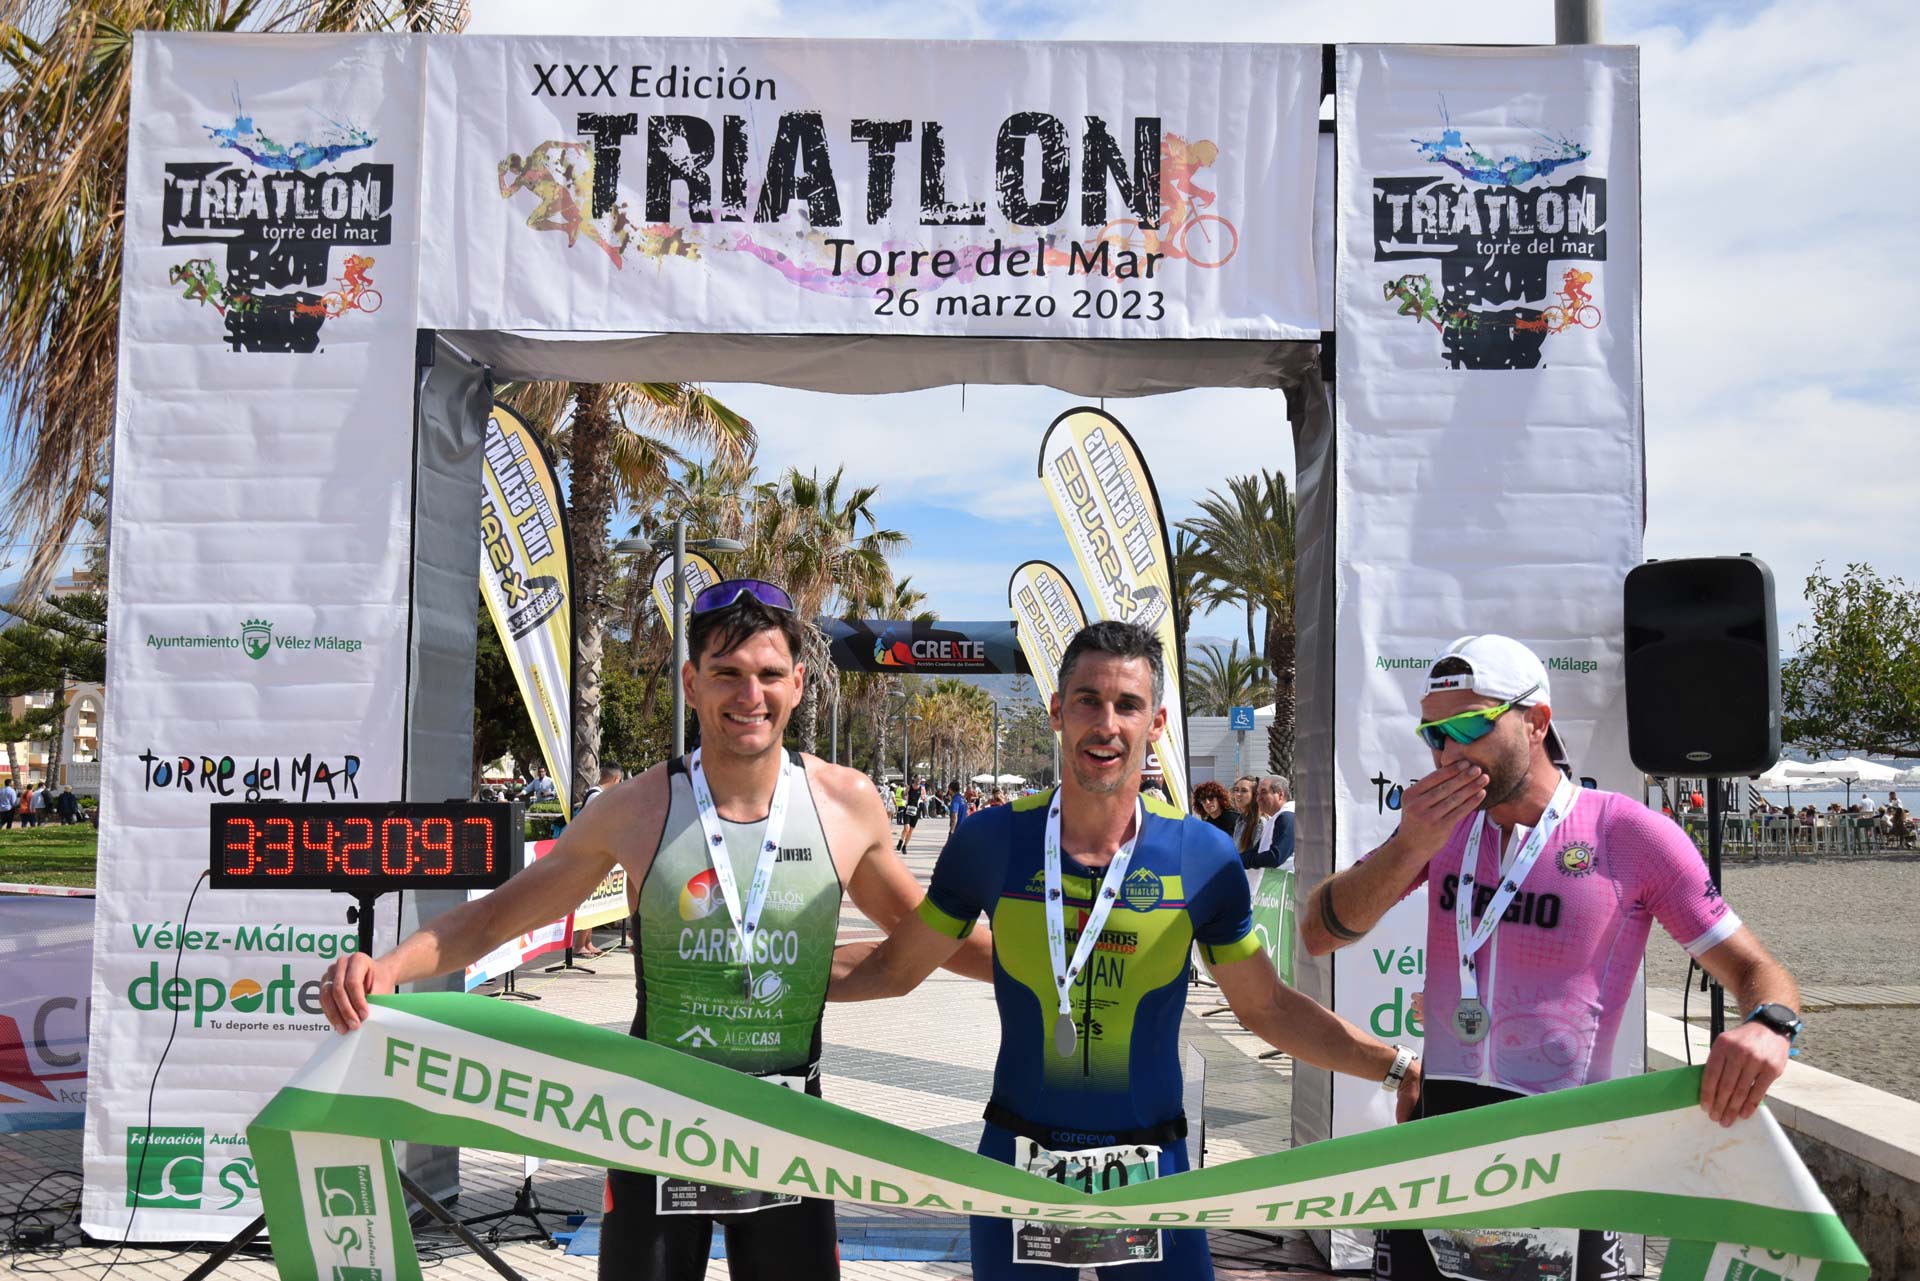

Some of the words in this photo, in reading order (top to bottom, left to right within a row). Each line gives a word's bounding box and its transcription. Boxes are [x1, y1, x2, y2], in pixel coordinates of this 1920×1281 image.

[530, 64, 619, 98] XXX
[631, 63, 777, 100] Edición
[577, 110, 1163, 231] TRIATLON
[175, 170, 382, 221] TRIATLON
[1386, 186, 1597, 235] TRIATLON
[262, 222, 305, 240] torre
[310, 224, 337, 239] del
[343, 225, 379, 240] mar
[1476, 239, 1521, 255] torre
[1527, 239, 1554, 255] del
[1561, 241, 1596, 257] mar
[824, 237, 962, 278] Torre
[975, 237, 1045, 277] del
[1069, 239, 1165, 279] Mar
[874, 287, 920, 317] 26
[936, 292, 1057, 318] marzo
[1072, 289, 1167, 321] 2023
[147, 634, 239, 649] Ayuntamiento
[275, 635, 311, 650] Vélez
[314, 636, 362, 653] Málaga
[911, 640, 985, 660] CREATE
[1548, 657, 1598, 674] Málaga
[132, 921, 360, 960] Vélez-Málaga
[210, 1020, 223, 1031] Tu
[226, 1020, 269, 1034] deporte
[273, 1023, 285, 1032] es
[288, 1021, 331, 1032] nuestra
[723, 1031, 782, 1047] ALEXCASA
[384, 1036, 760, 1179] FEDERACIÓN
[777, 1155, 1128, 1221] ANDALUZA
[1046, 1160, 1129, 1195] 110
[1255, 1153, 1562, 1223] TRIATLÓN
[1149, 1207, 1235, 1224] DE
